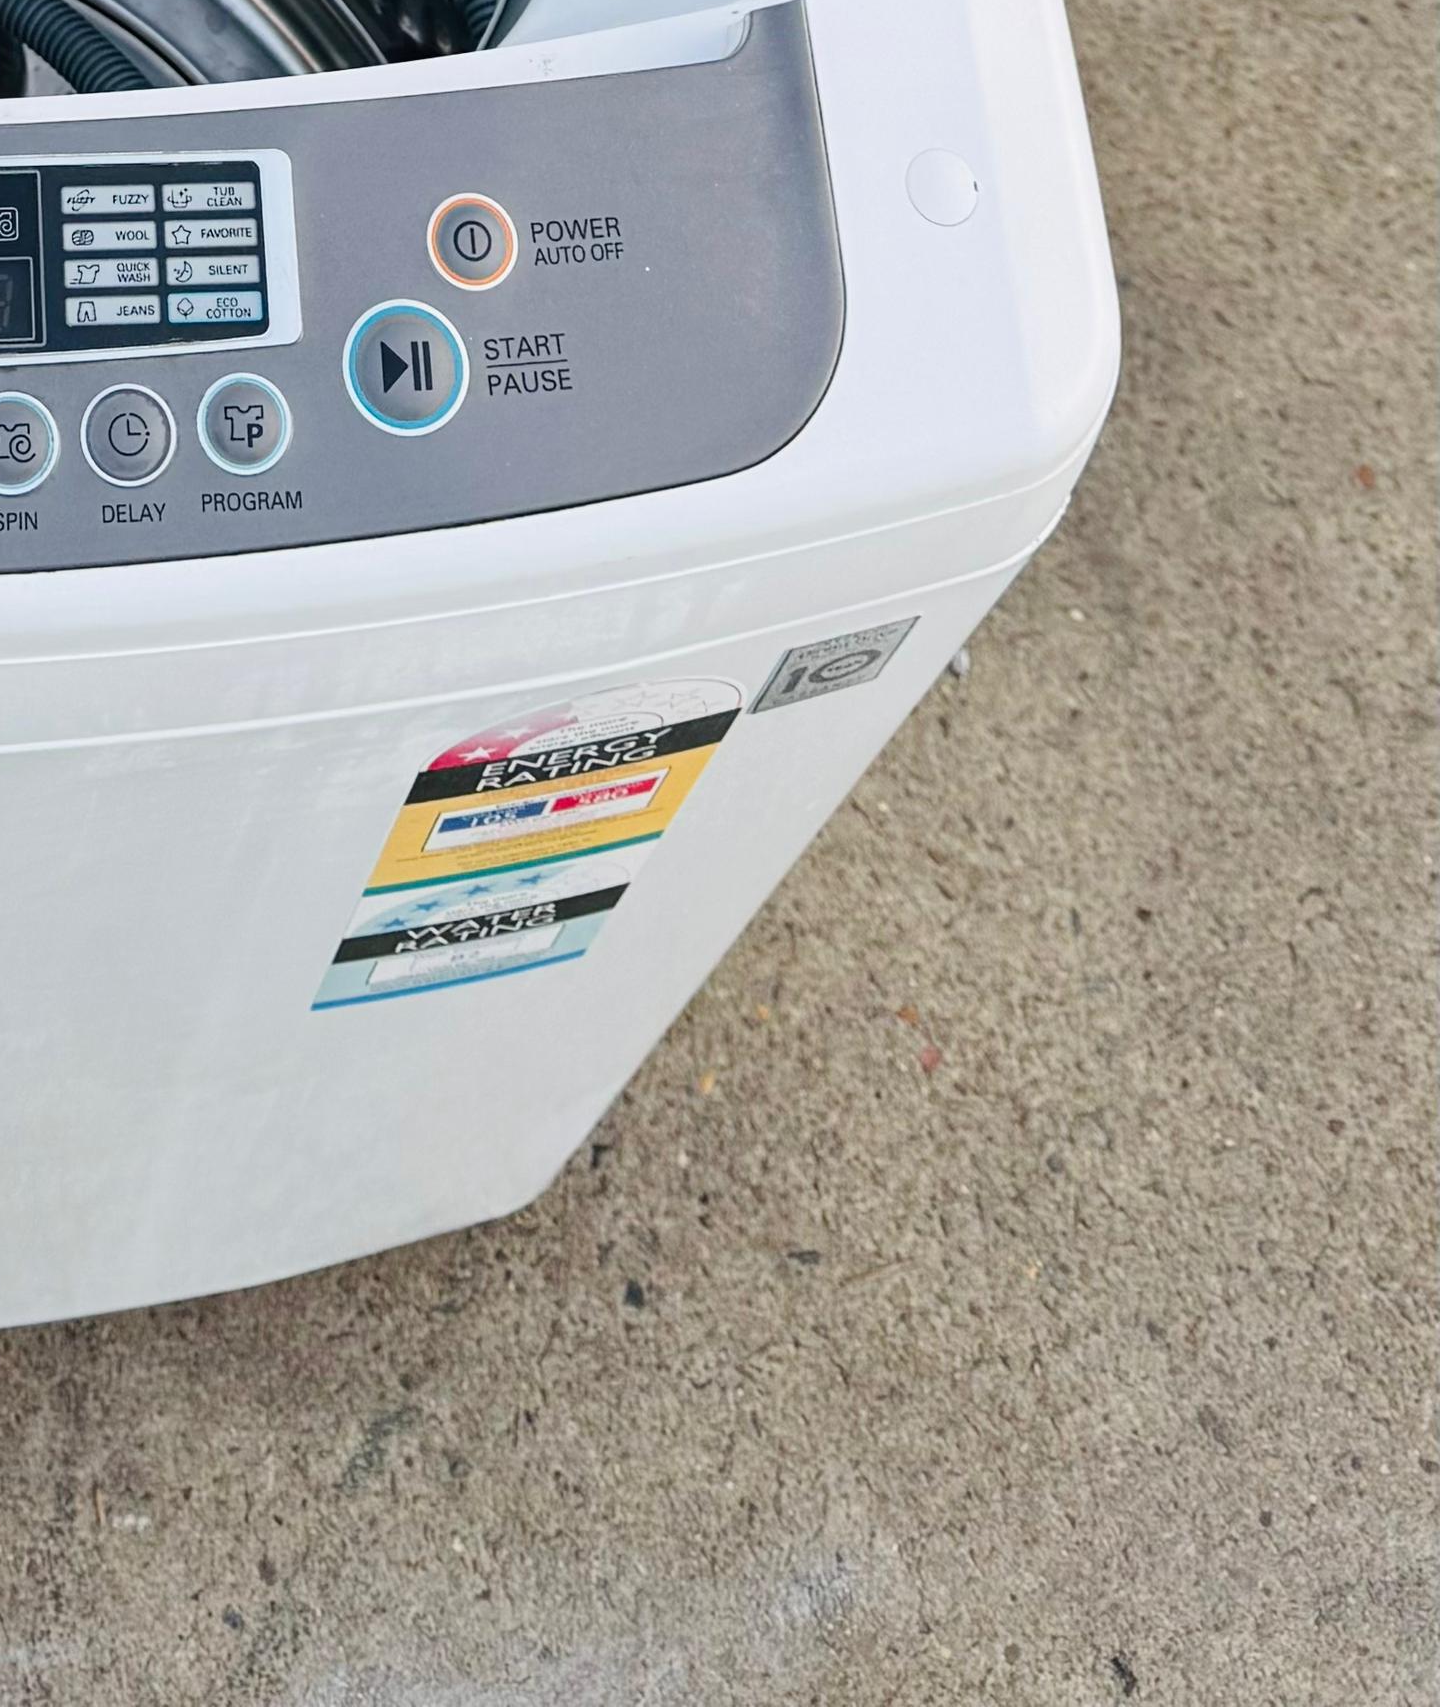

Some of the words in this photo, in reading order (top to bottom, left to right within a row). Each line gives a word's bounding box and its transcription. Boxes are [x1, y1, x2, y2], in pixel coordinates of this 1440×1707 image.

[213, 187, 235, 196] TUB
[112, 194, 149, 205] FUZZY
[206, 196, 242, 207] CLEAN
[115, 230, 150, 241] WOOL
[200, 227, 252, 238] FAVORITE
[530, 216, 622, 243] POWER
[534, 245, 585, 267] AUTO
[591, 242, 624, 262] OFF
[117, 261, 150, 273] QUICK
[208, 263, 249, 276] SILENT
[117, 272, 151, 283] WASH
[216, 297, 239, 308] ECO
[116, 304, 155, 317] JEANS
[206, 308, 252, 319] COTTON
[483, 333, 567, 361] START
[487, 368, 573, 396] PAUSE
[201, 491, 303, 513] PROGRAM
[102, 503, 166, 523] DELAY
[482, 727, 673, 778] ENERGY
[476, 745, 658, 793] RATING
[406, 902, 557, 941] WATER
[394, 916, 556, 955] RATING
